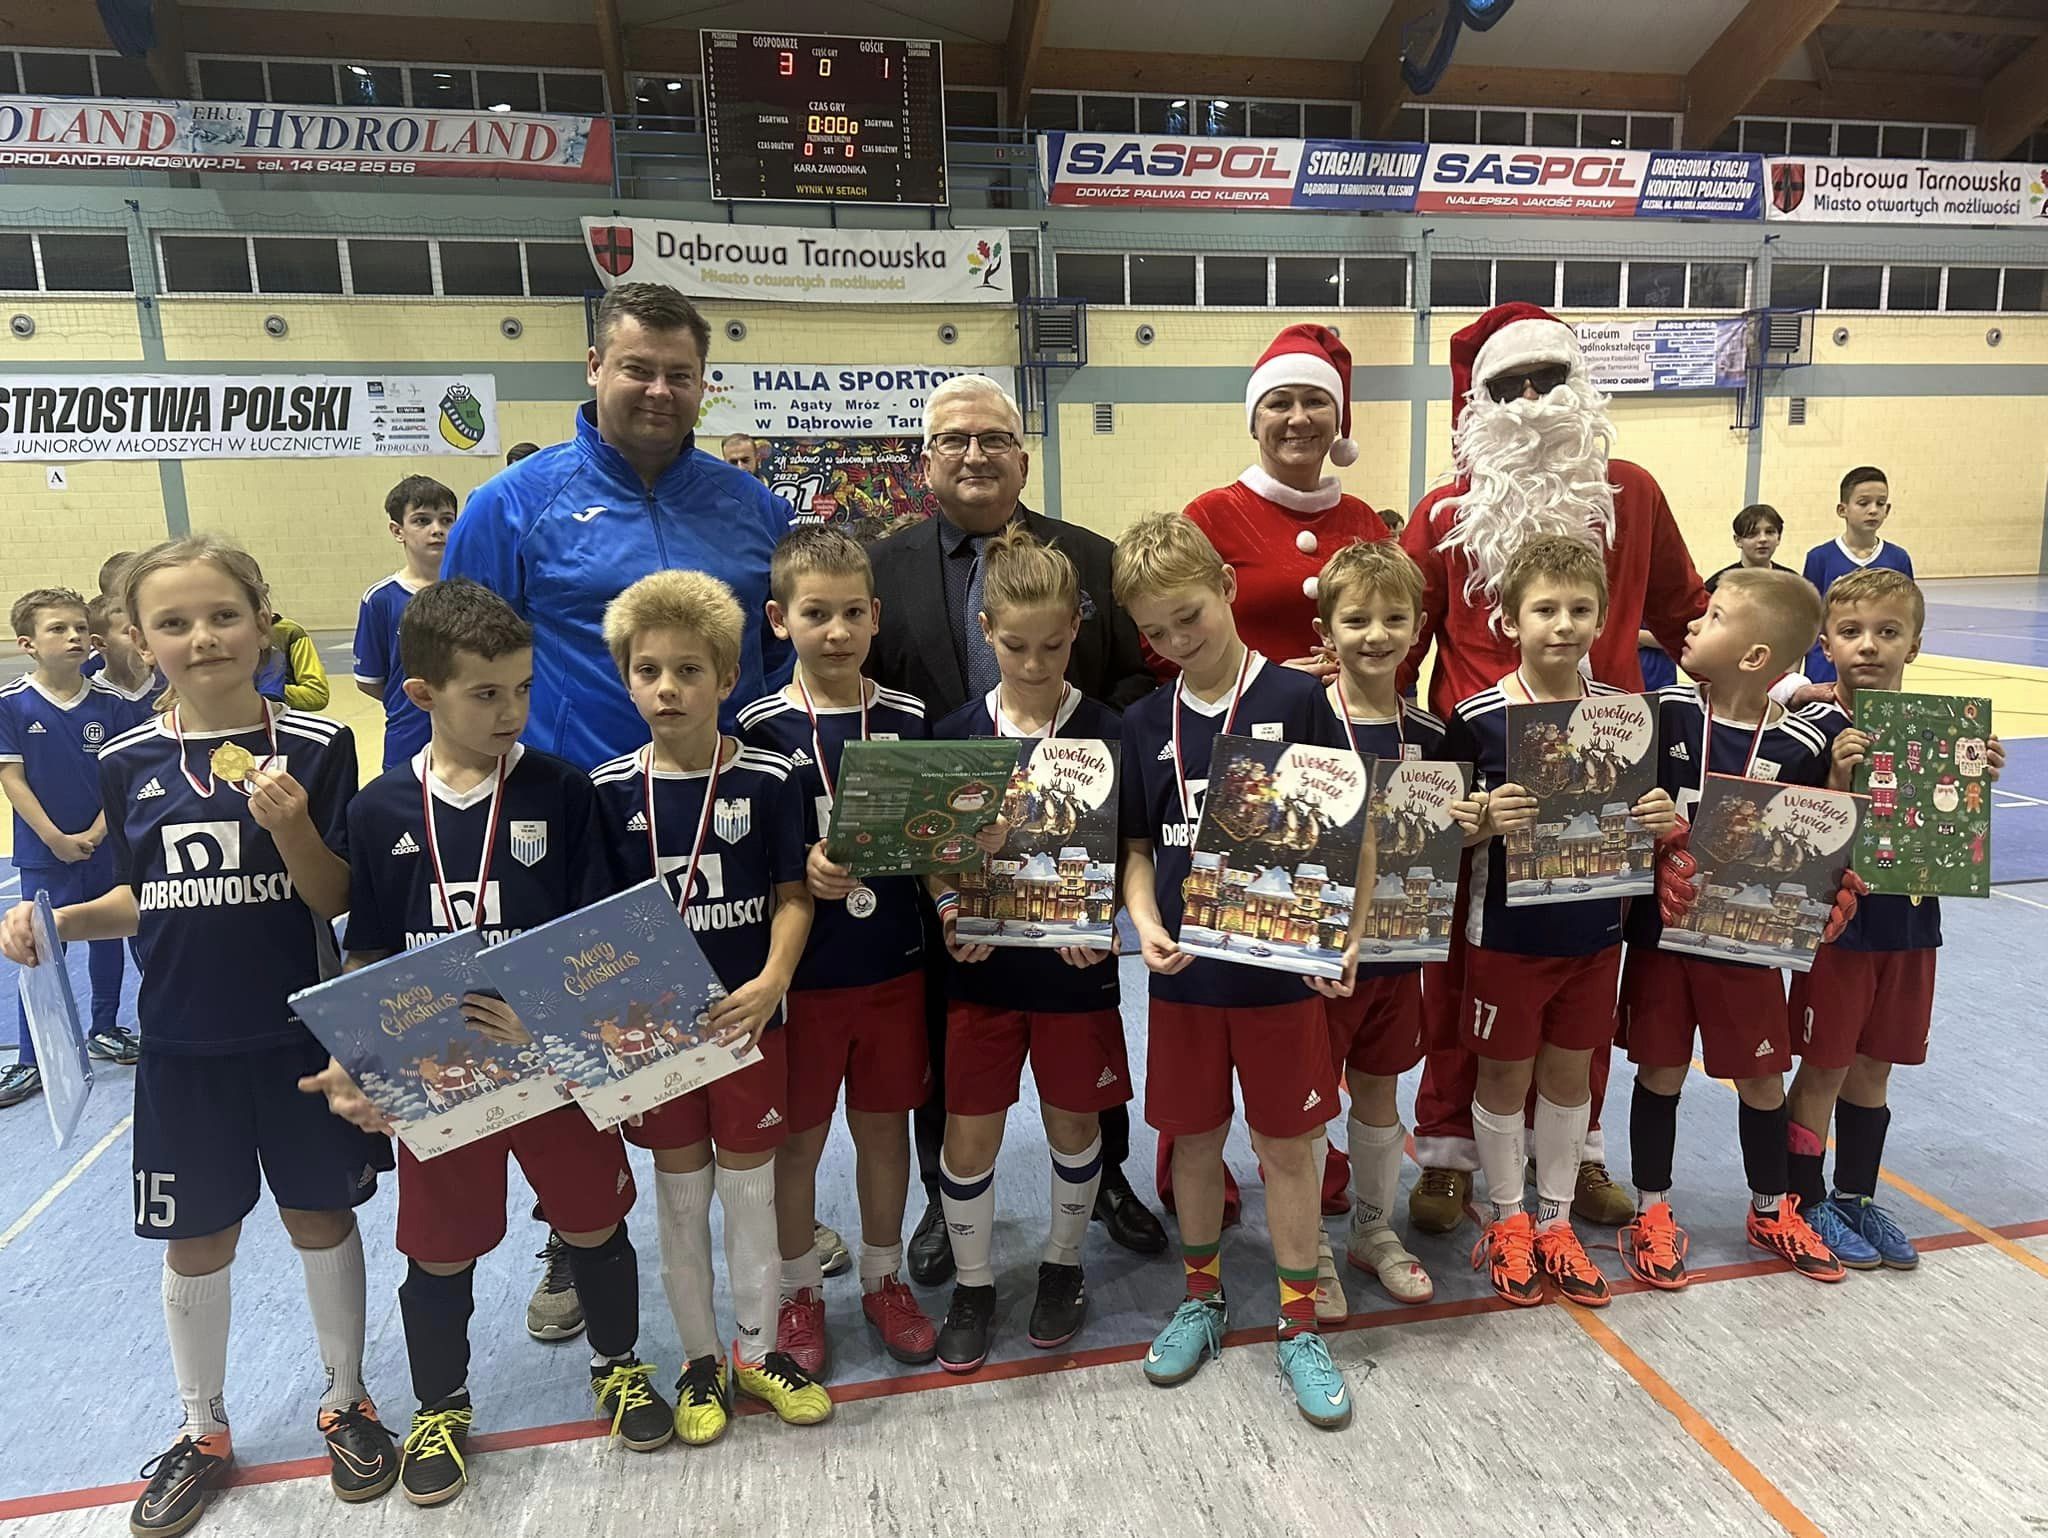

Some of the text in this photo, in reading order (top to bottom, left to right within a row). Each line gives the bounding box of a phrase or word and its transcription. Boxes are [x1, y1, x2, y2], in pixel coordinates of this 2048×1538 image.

[752, 36, 799, 49] GOSPODARZE
[860, 40, 884, 53] GOŚCIE
[780, 52, 793, 75] 3
[819, 58, 831, 76] 0
[884, 57, 889, 79] 1
[808, 101, 846, 112] CZAS GRY
[192, 107, 558, 161] F.H.U. HYDROLAND
[804, 142, 814, 156] 0
[845, 144, 855, 157] 0
[1066, 142, 1291, 179] SASPOL
[257, 159, 284, 171] tel.
[290, 161, 313, 172] 14
[317, 160, 356, 173] 642
[360, 162, 386, 173] 25
[390, 162, 416, 174] 56
[793, 163, 867, 175] KARA ZAWODNIKA
[1308, 151, 1421, 178] STACJA PALIW
[1433, 153, 1637, 188] SASPOL
[1651, 158, 1750, 179] OKRĘGOWA STACJA
[796, 185, 868, 196] WYNIK W SETACH
[1302, 183, 1414, 198] DĄBROWA TARNOWSKA, OLESNO
[1645, 179, 1756, 199] KONTROLI POJAZDÓW
[1815, 165, 2021, 193] Dąbrowa Tarnowska
[1076, 186, 1270, 201] DOWÓZ PALIWA DO KLIENTA
[1446, 195, 1616, 209] NAJLEPSZA JAKOŚĆ PALIW
[1814, 194, 2020, 217] Miasto otwartych możliwości
[657, 231, 946, 268] Dąbrowa Tarnowska
[701, 268, 906, 292] Miasto otwartych możliwości
[1581, 328, 1620, 339] Liceum
[1579, 342, 1651, 354] gólnokształcące
[753, 370, 985, 392] HALA SPORTO
[221, 385, 352, 433] POLSKI
[754, 398, 880, 412] im. Agaty Mróz
[755, 419, 771, 429] w
[787, 415, 873, 432] Dąbrowie
[13, 437, 112, 454] JUNIORÓW
[115, 437, 222, 453] MŁODSZYCH
[228, 437, 246, 451] W
[250, 436, 362, 452] ŁUCZNICTWIE
[51, 471, 64, 484] A
[773, 472, 799, 481] 2023
[771, 476, 824, 514] 31
[1581, 704, 1647, 727] Wesołych
[1592, 721, 1632, 742] Świąt
[1042, 745, 1106, 773] Wesołych
[1291, 753, 1359, 788] Wesołych
[1053, 761, 1094, 786] Świąt
[1401, 769, 1458, 795] Wesołych
[137, 788, 166, 800] adidas
[1301, 772, 1343, 800] Świąt
[1408, 784, 1445, 808] Świąt
[1784, 795, 1849, 825] Wesołych
[1791, 809, 1832, 834] Świąt
[626, 824, 649, 832] adida
[391, 844, 420, 856] adidas
[563, 942, 616, 973] Merry
[563, 950, 641, 997] Christmas
[380, 984, 432, 1015] Merry
[380, 993, 458, 1037] Christmas
[1473, 997, 1499, 1040] 17
[1803, 1005, 1814, 1044] 9
[475, 1110, 527, 1136] MAGNETIC
[136, 1169, 176, 1228] 15
